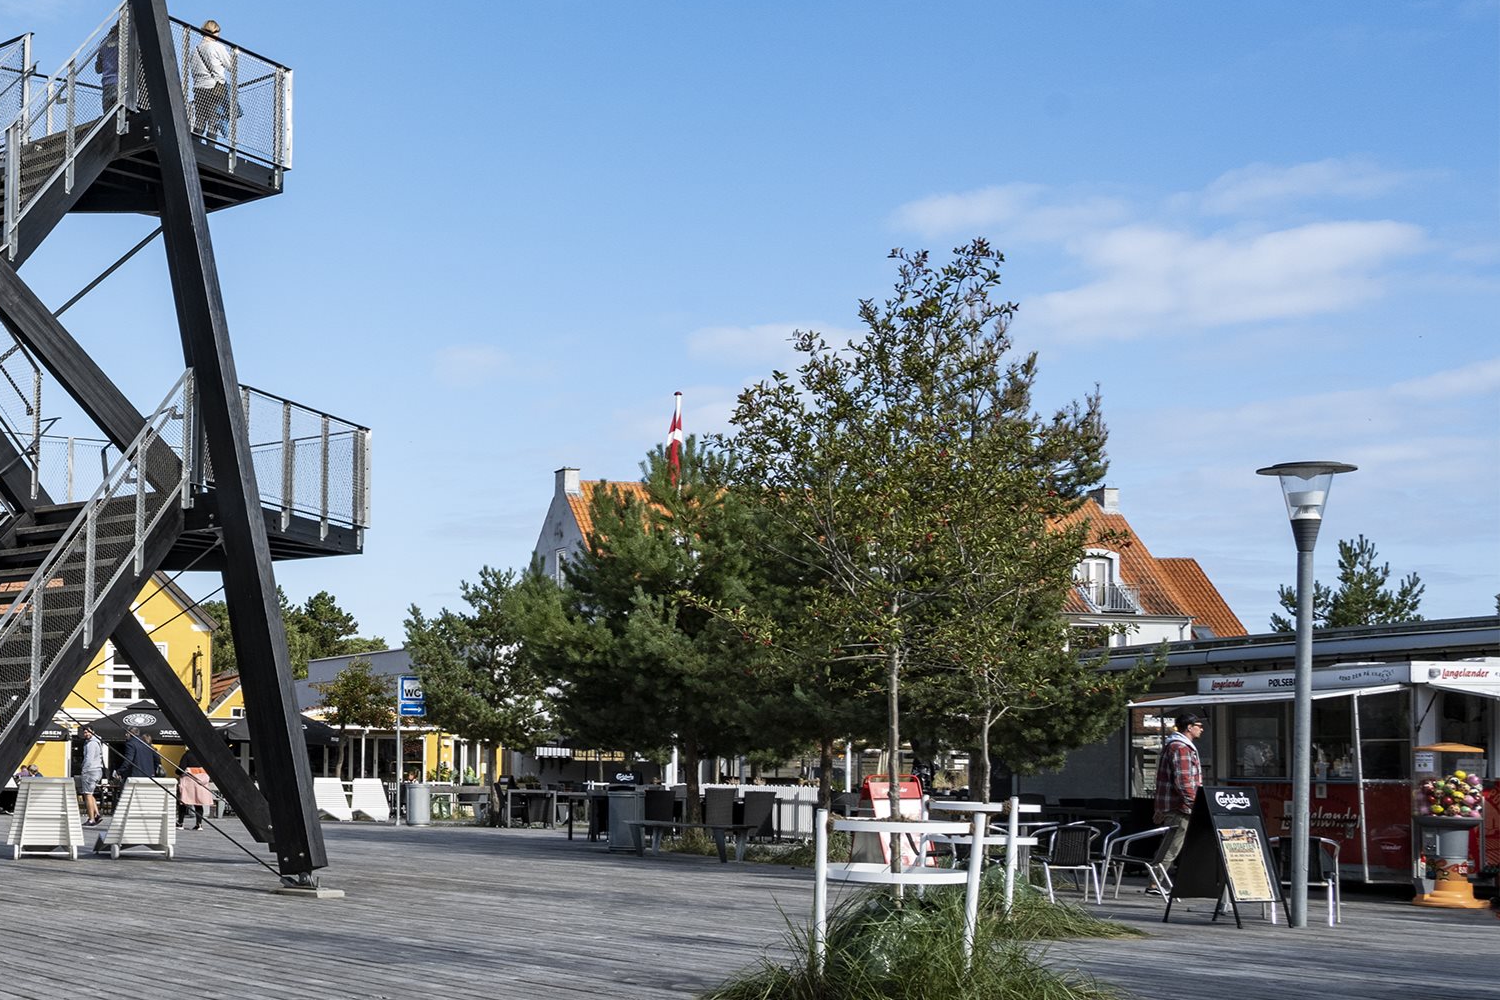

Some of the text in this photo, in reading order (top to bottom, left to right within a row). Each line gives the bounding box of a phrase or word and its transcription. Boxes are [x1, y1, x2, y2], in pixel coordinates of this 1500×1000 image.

[1442, 668, 1489, 679] Langelænder
[1211, 679, 1244, 691] Langelænder
[404, 689, 422, 698] WC
[1215, 792, 1251, 810] Carlsberg
